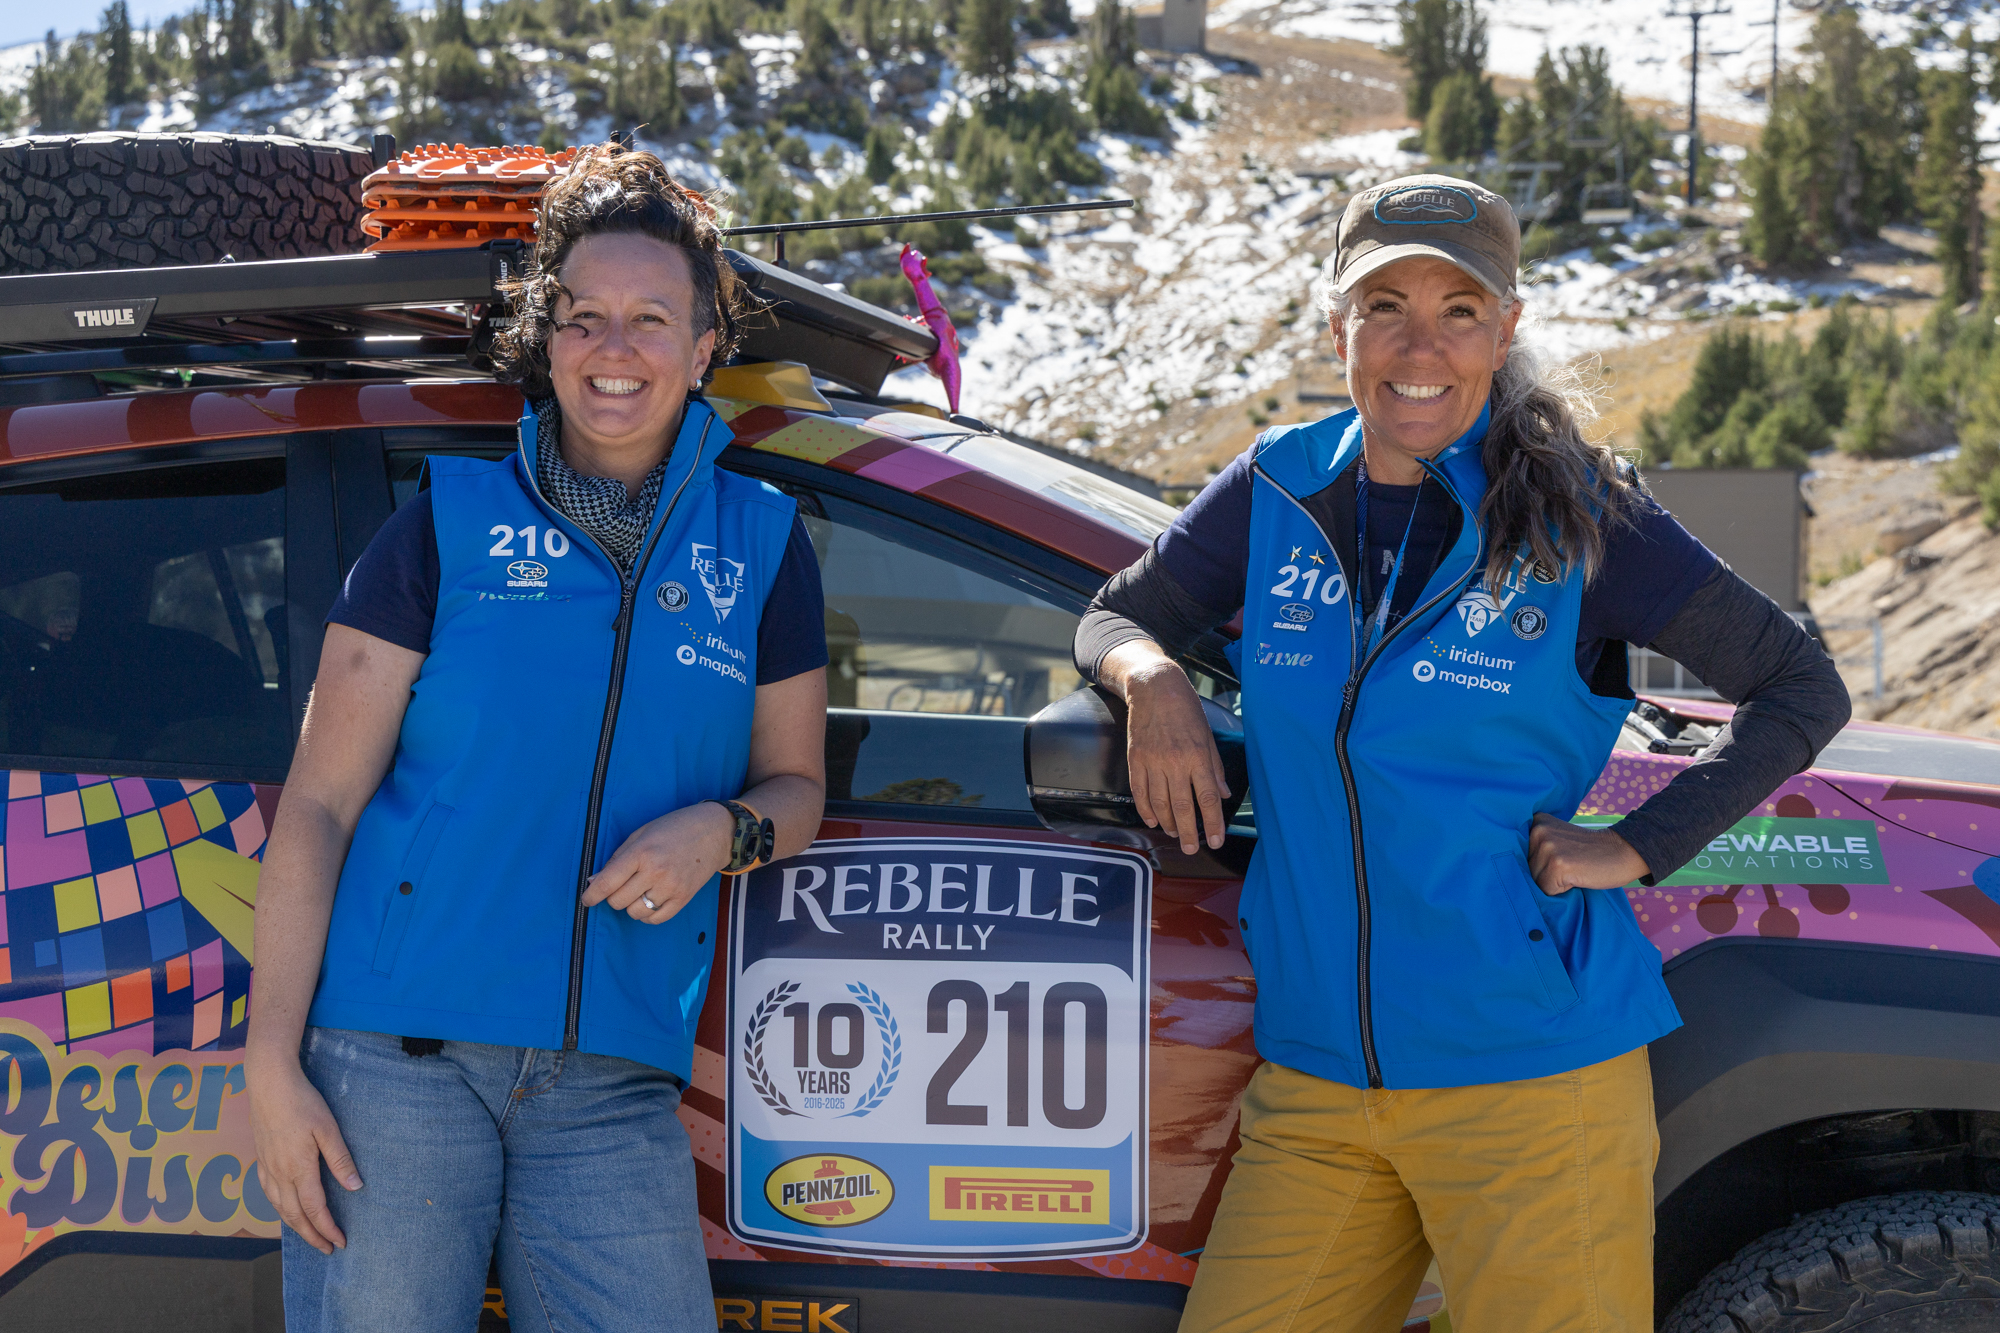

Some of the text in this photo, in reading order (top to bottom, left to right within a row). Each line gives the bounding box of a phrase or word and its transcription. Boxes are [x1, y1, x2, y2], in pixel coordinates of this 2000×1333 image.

[1395, 193, 1455, 208] REBELLE
[74, 309, 135, 327] THULE
[489, 524, 570, 558] 210
[690, 556, 745, 593] RELLE
[1270, 564, 1347, 605] 210
[1272, 621, 1307, 632] SUBARU
[1469, 615, 1485, 624] YEARS
[699, 655, 747, 686] mapbox
[1449, 645, 1513, 671] iridium
[1439, 670, 1512, 694] mapbox
[1701, 833, 1871, 854] EWABLE
[1695, 855, 1874, 870] OVATIONS
[777, 863, 1101, 934] REBELLE
[883, 923, 996, 950] RALLY
[783, 1002, 865, 1069] 10
[925, 979, 1108, 1129] 210
[0, 1033, 247, 1136] Deser
[797, 1070, 851, 1095] YEARS
[804, 1097, 846, 1110] 2016-2025
[782, 1174, 876, 1206] PENNZOIL
[944, 1177, 1095, 1213] PIRELLI
